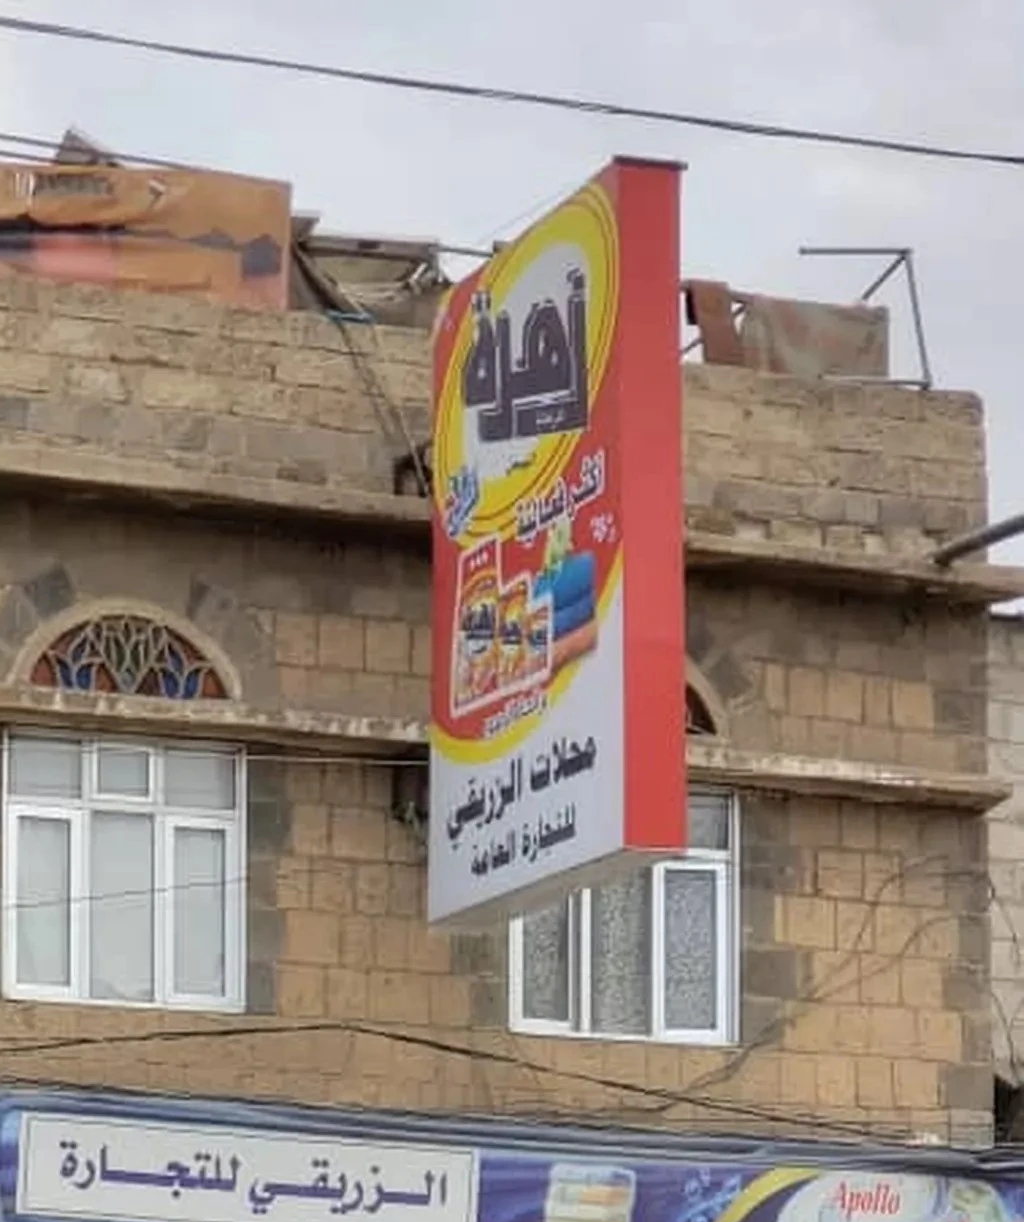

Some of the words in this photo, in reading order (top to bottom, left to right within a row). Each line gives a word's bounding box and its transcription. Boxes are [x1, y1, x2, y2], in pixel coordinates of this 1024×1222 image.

[530, 736, 597, 792] محلات
[447, 757, 522, 851] الزريقي
[522, 801, 576, 863] للتجارة
[837, 1180, 901, 1218] Apollo
